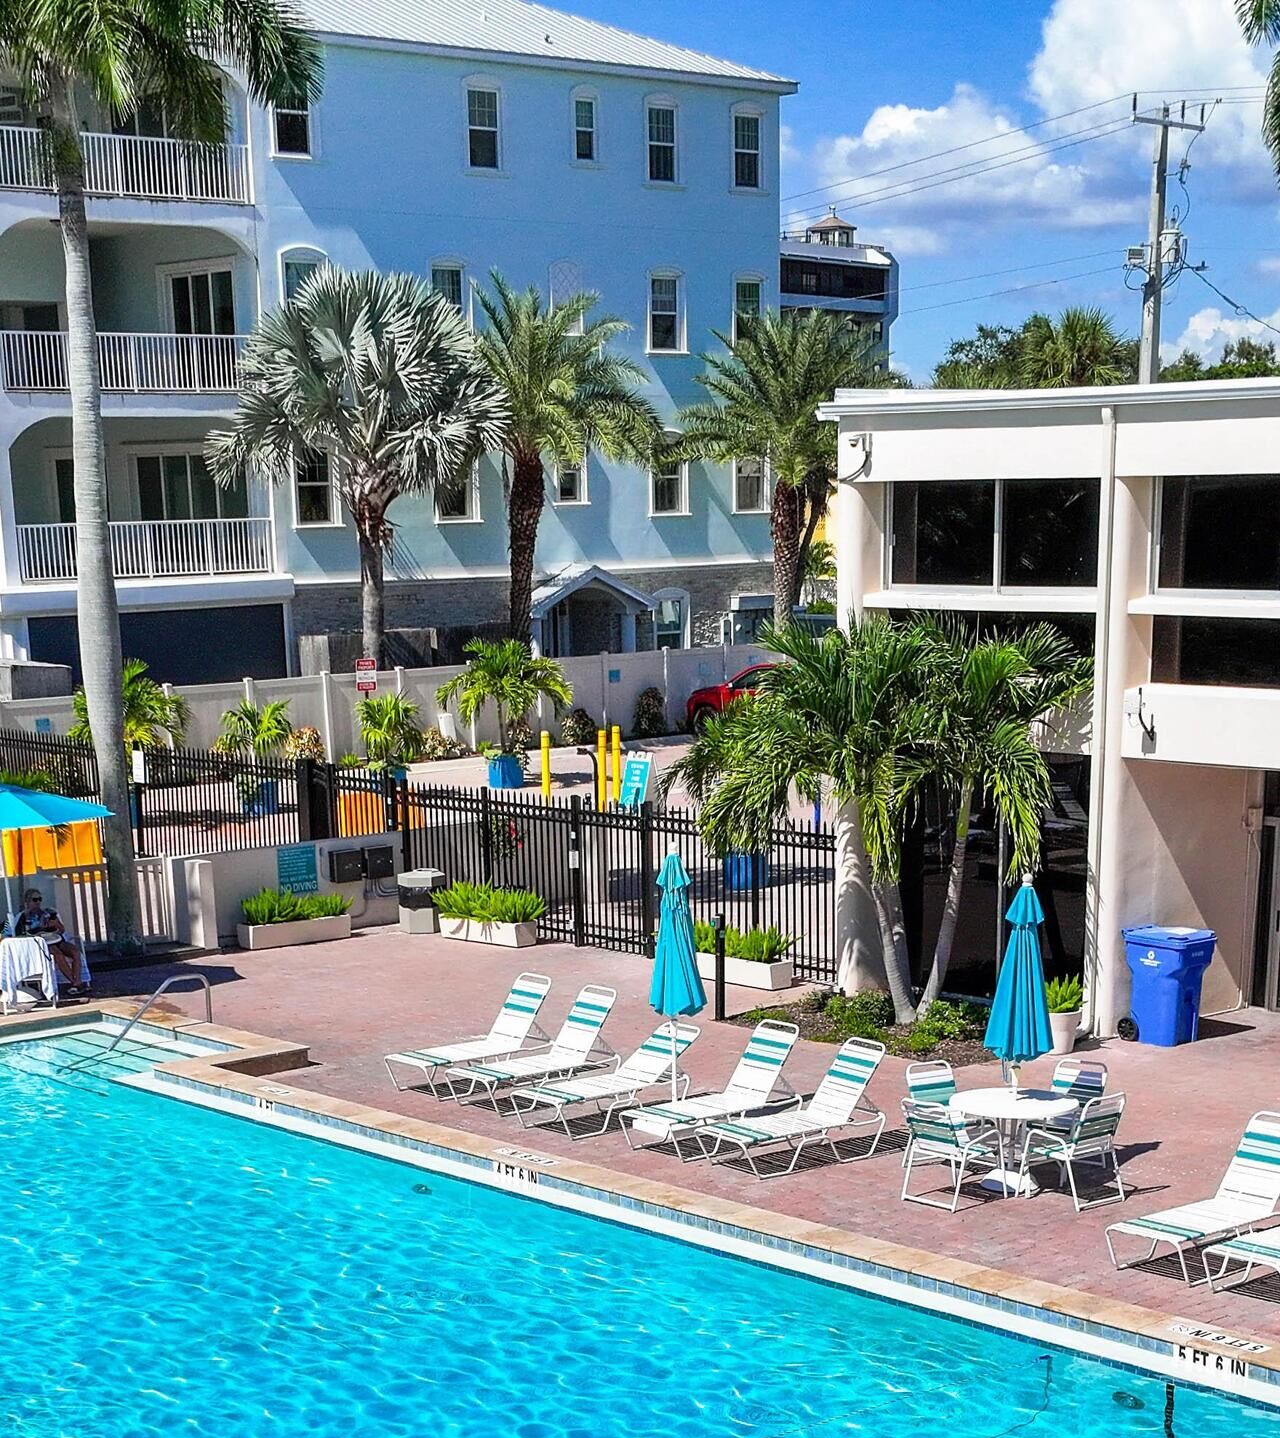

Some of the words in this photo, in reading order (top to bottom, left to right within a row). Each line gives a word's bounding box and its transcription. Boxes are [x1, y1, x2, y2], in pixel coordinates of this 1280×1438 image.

[280, 883, 292, 894] NO
[292, 880, 317, 892] DIVING
[505, 1164, 515, 1177] FT
[528, 1170, 537, 1184] IN
[1189, 1330, 1212, 1338] IN
[1224, 1340, 1250, 1348] FT
[1179, 1345, 1186, 1359] 5
[1193, 1349, 1209, 1366] FT
[1215, 1355, 1223, 1370] 6
[1231, 1359, 1246, 1377] IN
